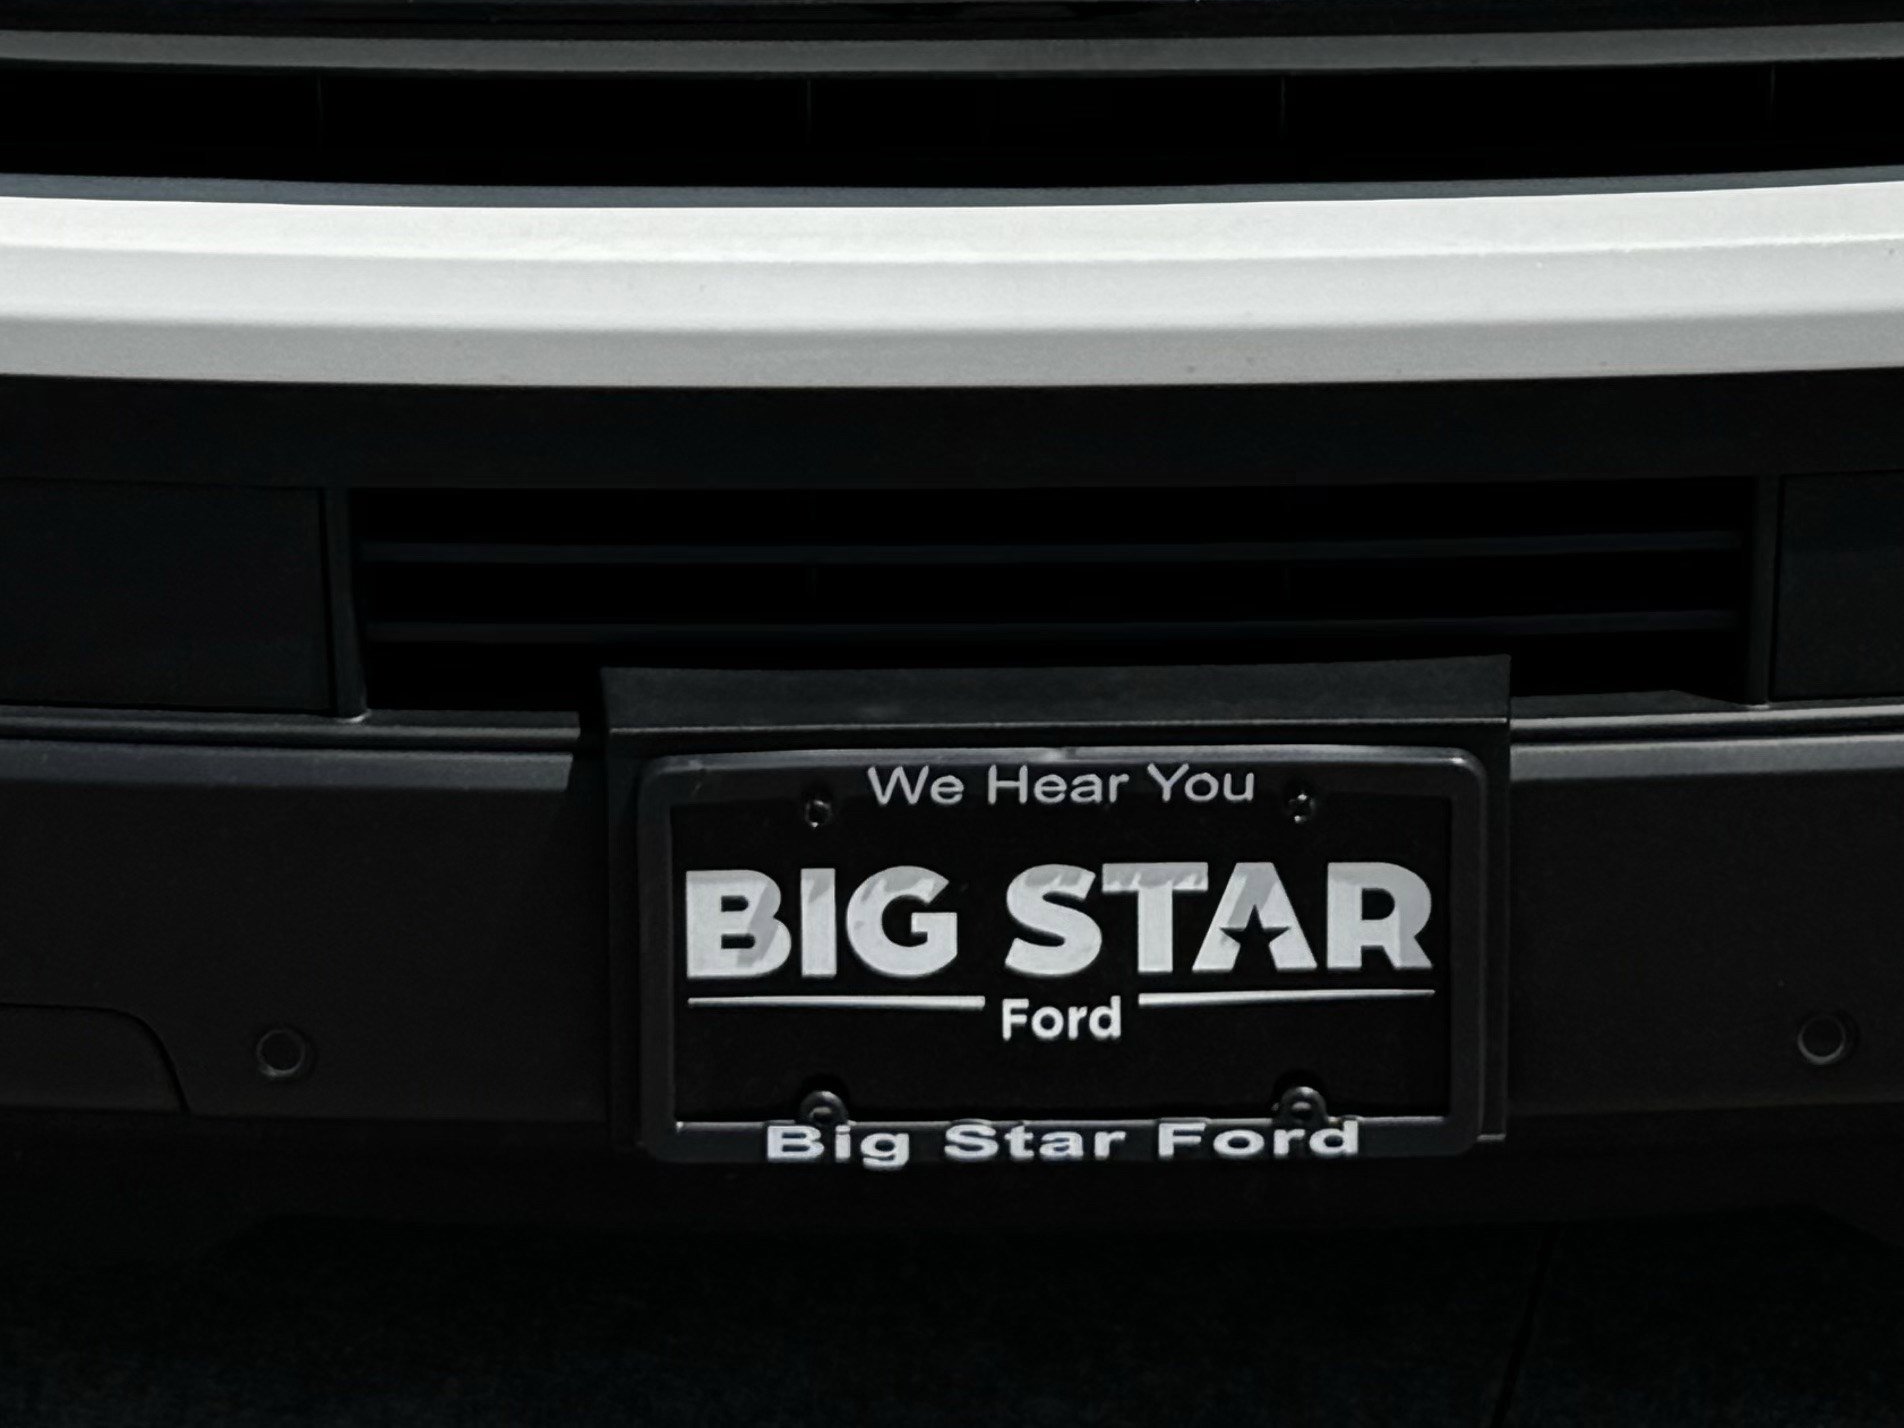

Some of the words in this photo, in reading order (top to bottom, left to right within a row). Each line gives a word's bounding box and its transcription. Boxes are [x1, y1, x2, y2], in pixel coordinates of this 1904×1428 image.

[867, 764, 964, 806] We
[987, 763, 1130, 805] Hear
[1146, 762, 1255, 803] You
[686, 865, 958, 979] BIG
[1004, 861, 1433, 978] STAR
[1001, 996, 1122, 1041] Ford
[766, 1124, 911, 1169] Big
[944, 1122, 1128, 1161] Star
[1158, 1120, 1360, 1158] Ford
